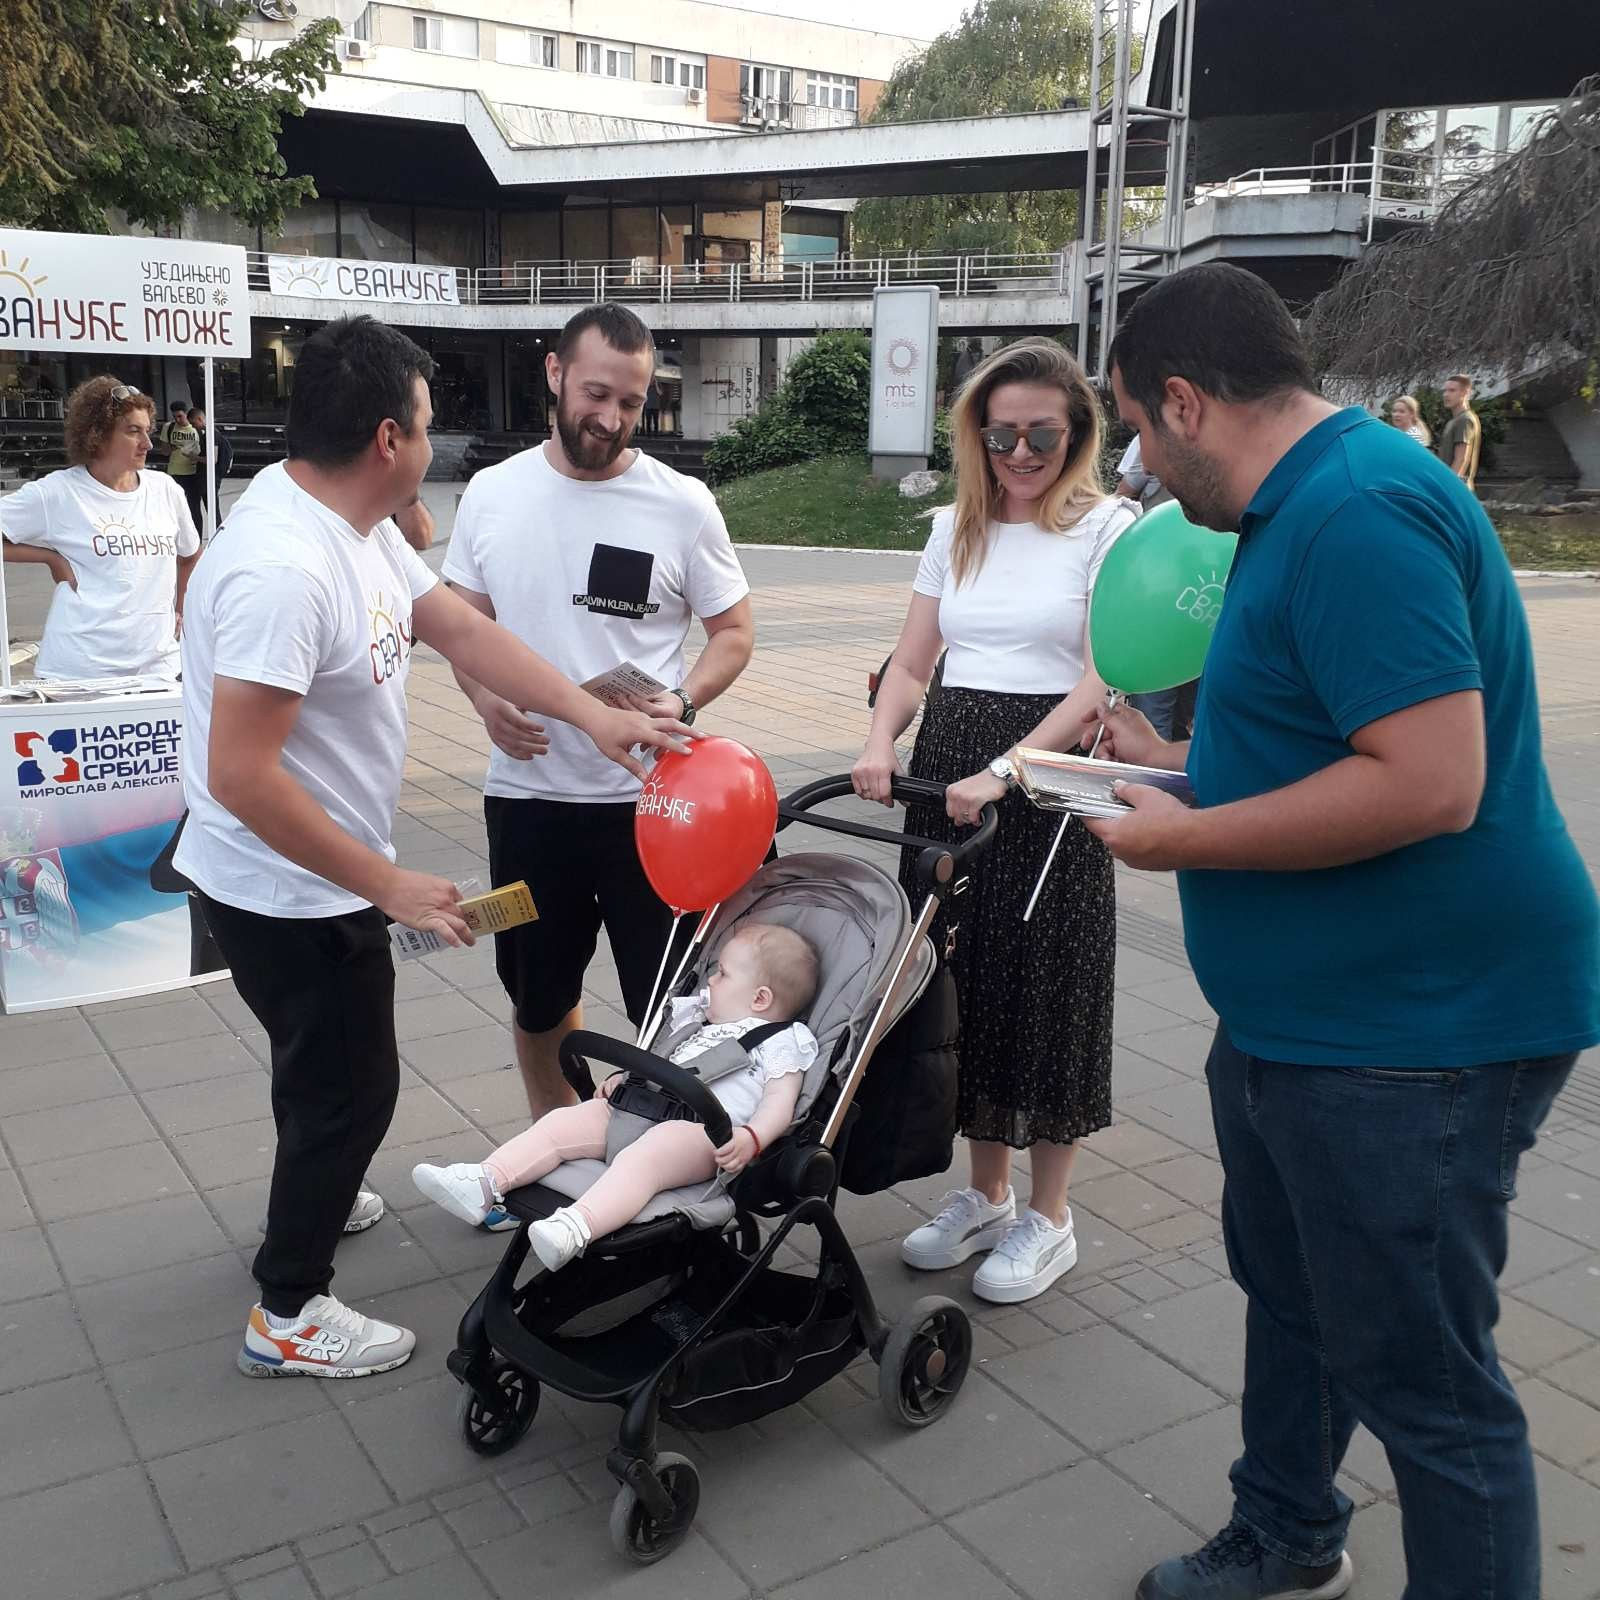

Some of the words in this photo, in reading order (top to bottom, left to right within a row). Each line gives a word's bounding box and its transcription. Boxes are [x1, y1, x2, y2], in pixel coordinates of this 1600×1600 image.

[141, 261, 231, 284] УЈЕДИЊЕНО
[337, 265, 453, 302] СВАНУЋЕ
[143, 284, 206, 305] ВАЉЕВО
[144, 307, 233, 346] МОЖЕ
[885, 383, 916, 398] mts
[172, 431, 196, 441] DENIM
[92, 534, 176, 557] СВАНУЋЕ
[574, 595, 607, 608] CALVIN
[607, 599, 634, 612] KLEIN
[633, 603, 659, 613] JEANS
[82, 737, 181, 762] ПОКРЕТ
[83, 756, 179, 781] СРБИЈЕ
[20, 782, 107, 799] МИРОСЛАВ
[111, 774, 180, 790] АЛЕКСИЋ
